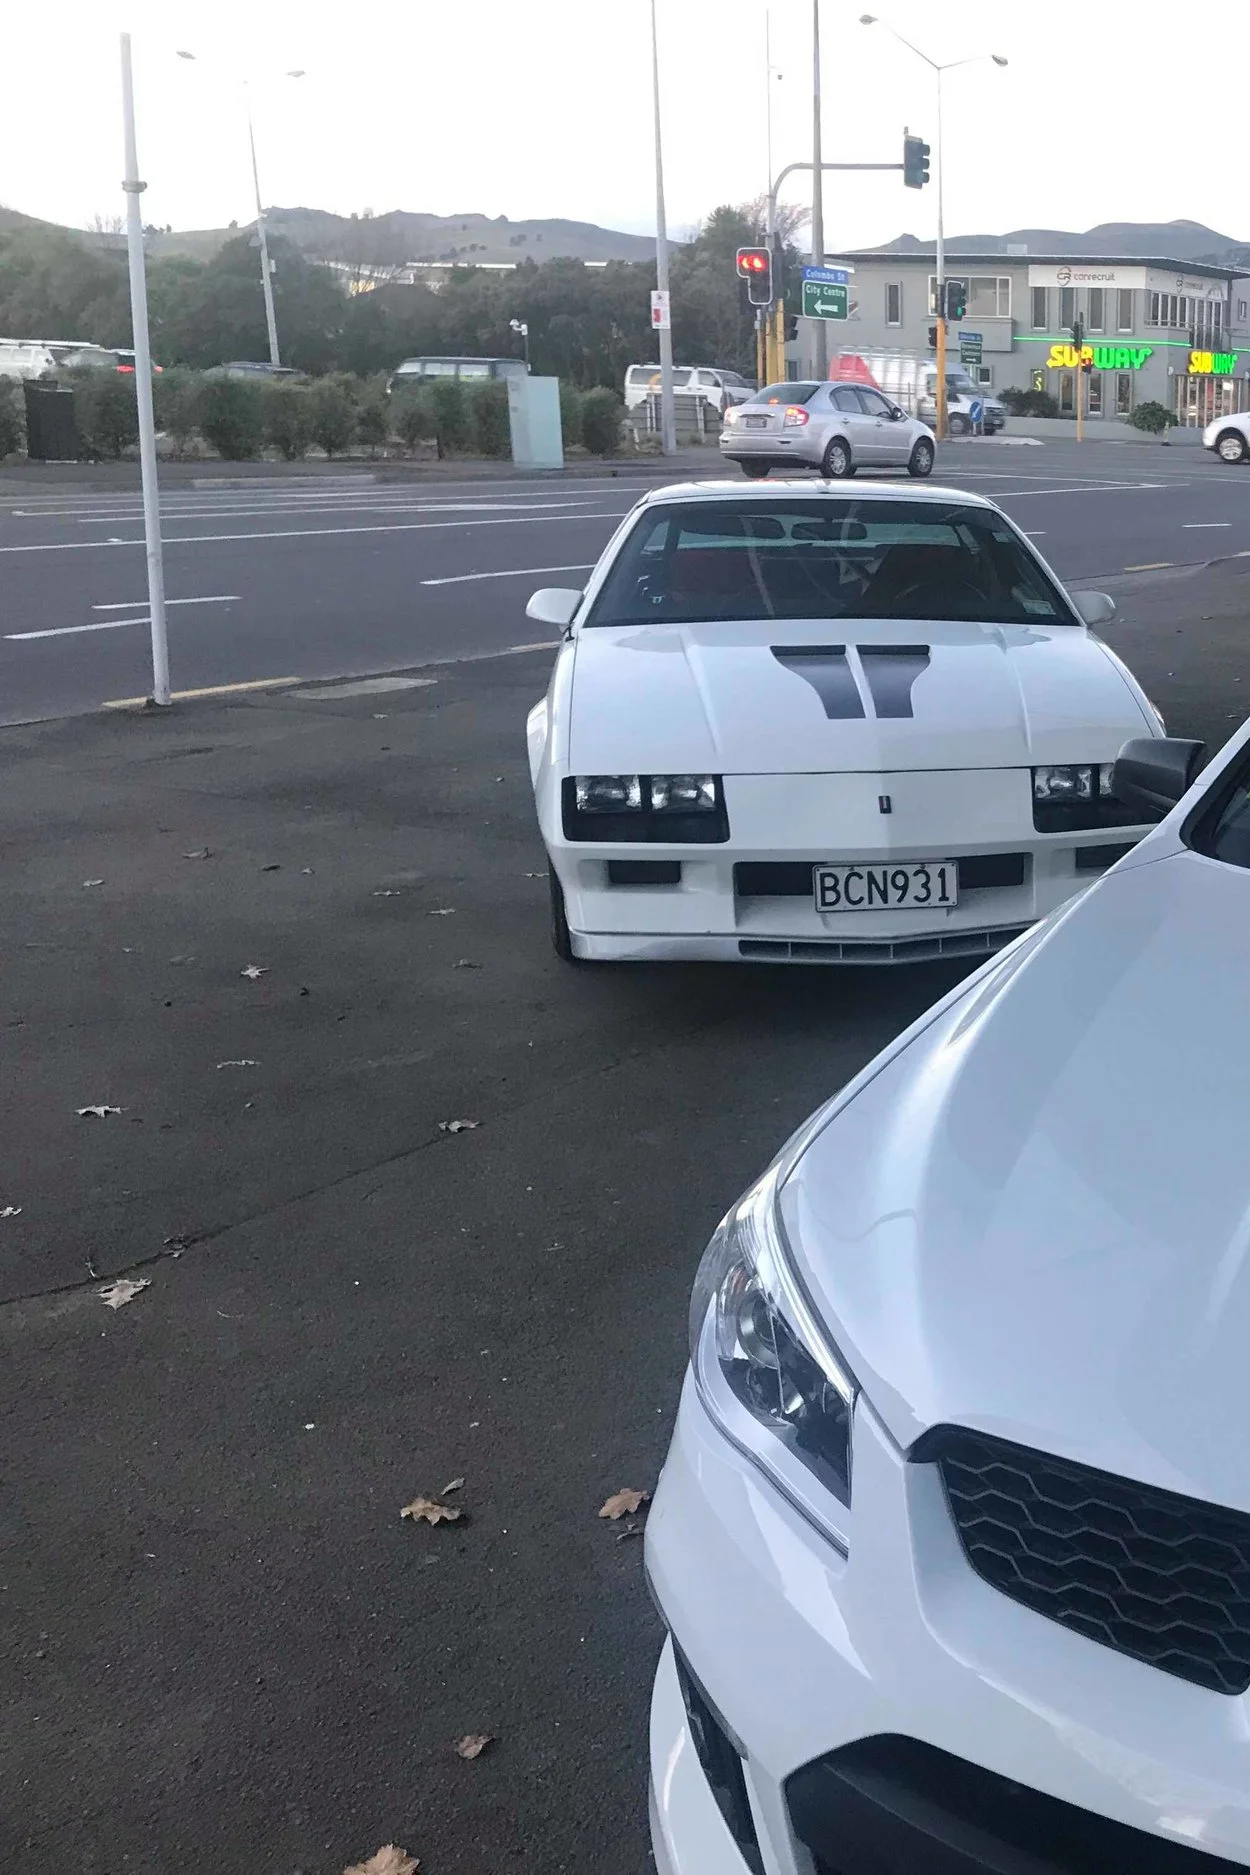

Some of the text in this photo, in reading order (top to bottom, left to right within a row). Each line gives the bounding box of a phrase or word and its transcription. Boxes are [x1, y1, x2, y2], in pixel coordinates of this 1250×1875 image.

[805, 268, 846, 281] Colombo St
[805, 284, 846, 298] City Centre
[1046, 344, 1153, 370] SUBWAY
[1187, 350, 1238, 374] SUBWAY
[819, 867, 950, 907] BCN931
